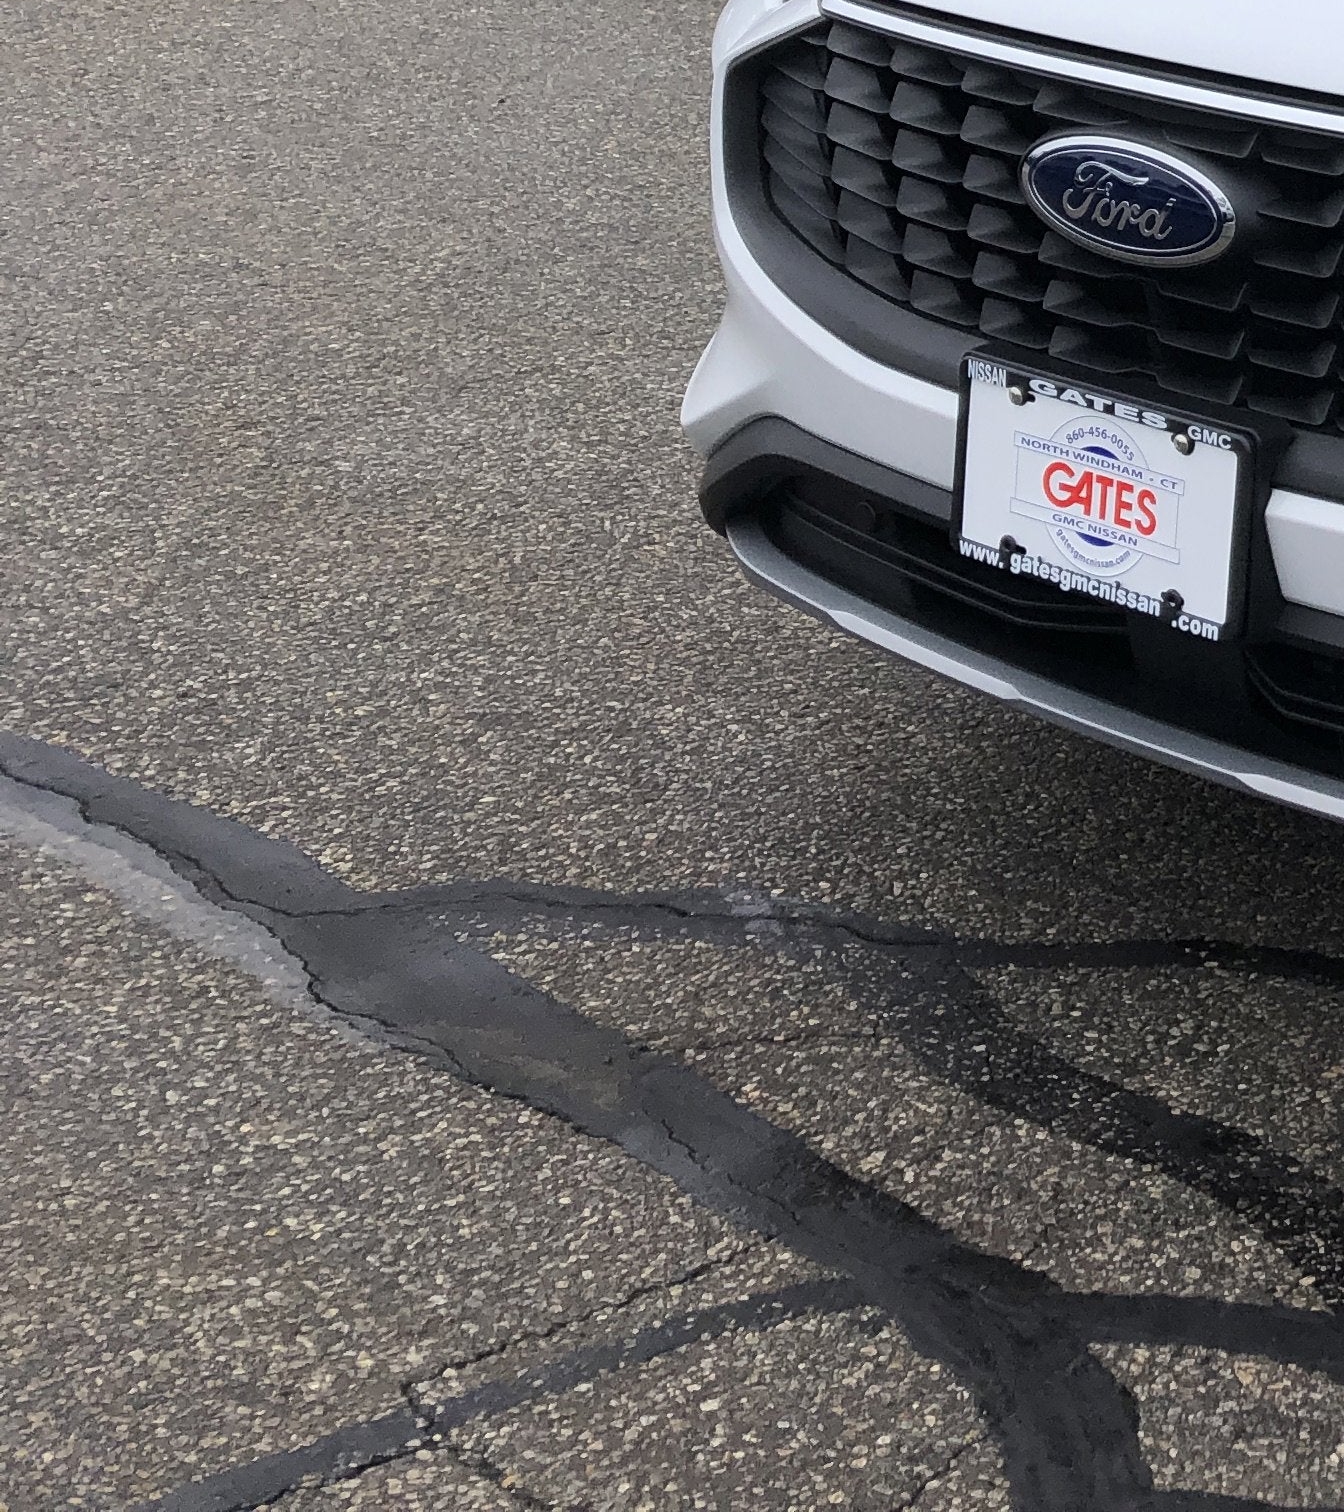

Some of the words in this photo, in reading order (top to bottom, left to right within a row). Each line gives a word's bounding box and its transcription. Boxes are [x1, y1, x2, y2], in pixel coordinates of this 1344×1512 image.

[1062, 160, 1177, 241] Ford
[967, 358, 1007, 388] NISSAN
[1028, 379, 1168, 430] GATES
[1065, 426, 1135, 462] 860-456-0055
[1186, 426, 1232, 450] GMC
[1020, 436, 1070, 458] NORTH
[1072, 450, 1143, 480] WINDHAM
[1160, 478, 1178, 490] CT
[1042, 461, 1157, 536] GATES
[1052, 513, 1084, 529] GMC
[1087, 523, 1138, 547] NISSAN
[1056, 528, 1131, 568] gatesgmcnissan.com
